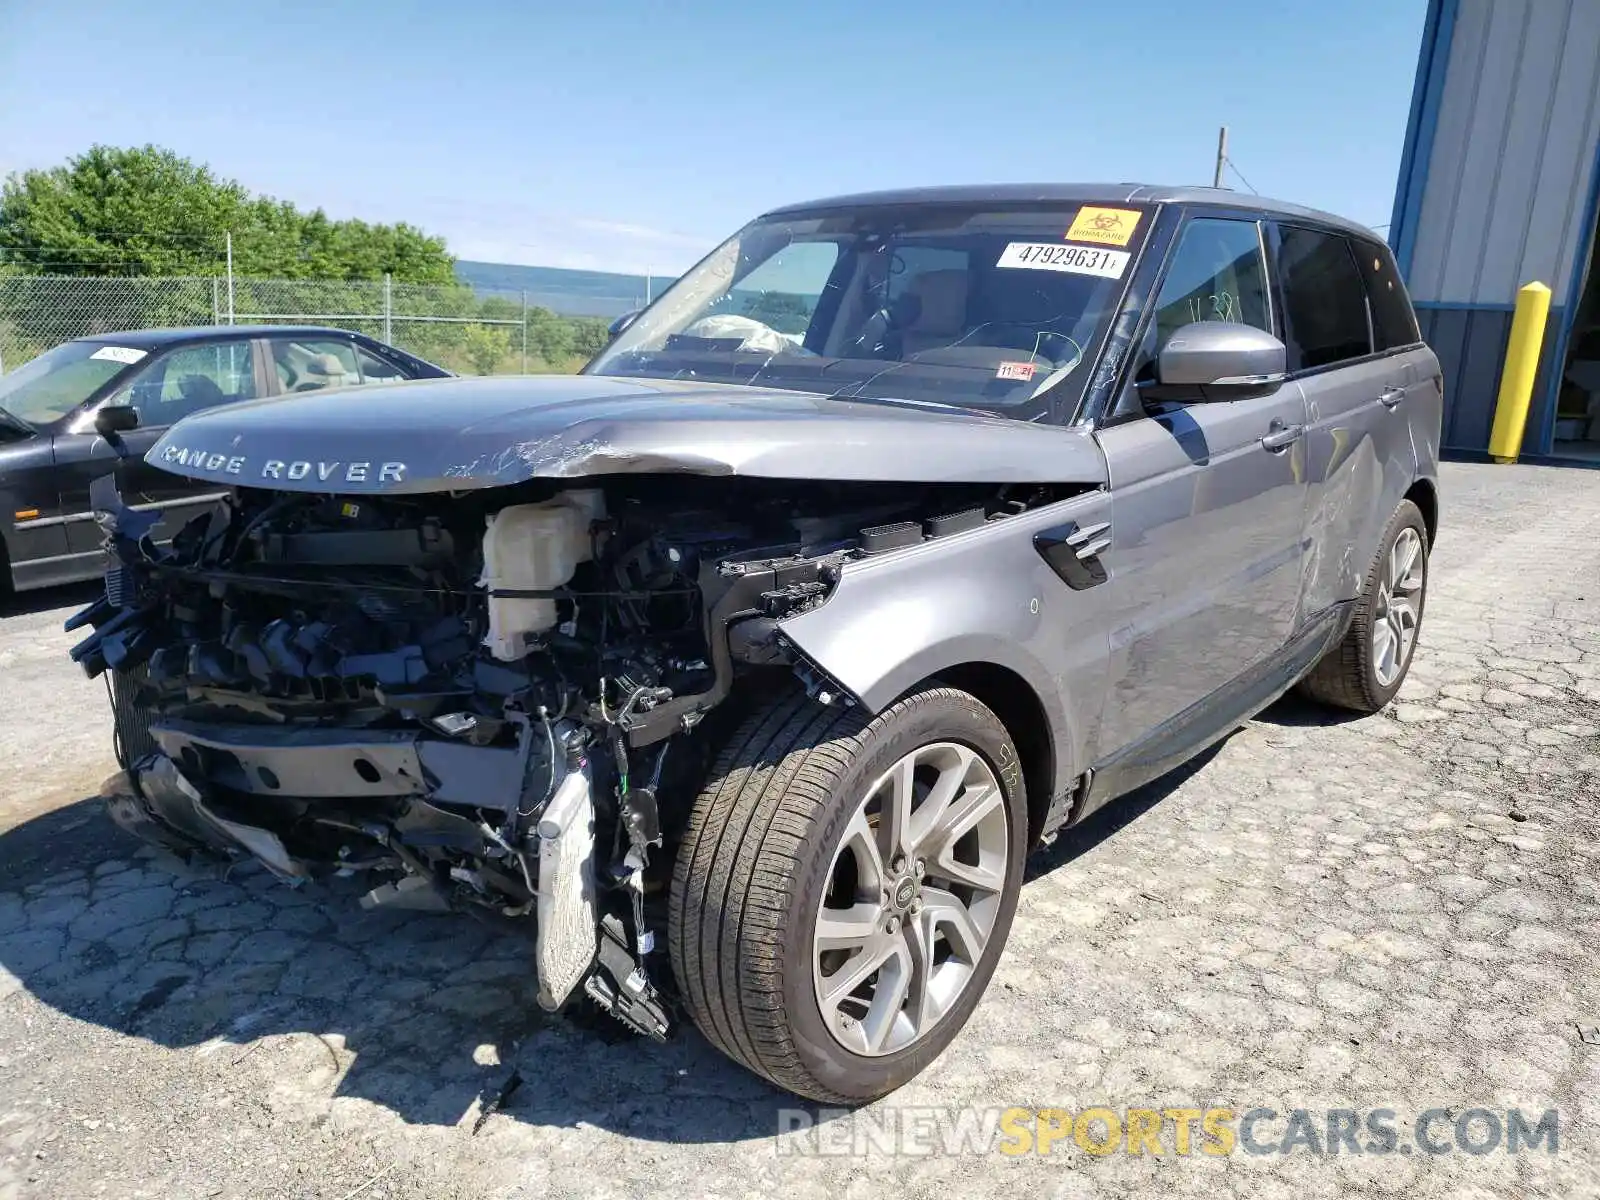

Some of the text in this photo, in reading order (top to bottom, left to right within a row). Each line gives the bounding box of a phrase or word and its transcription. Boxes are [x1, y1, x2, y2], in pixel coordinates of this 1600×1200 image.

[1073, 229, 1125, 241] BIOHAZARD
[1019, 245, 1111, 270] 47929631
[160, 445, 407, 483] RANGE ROVER
